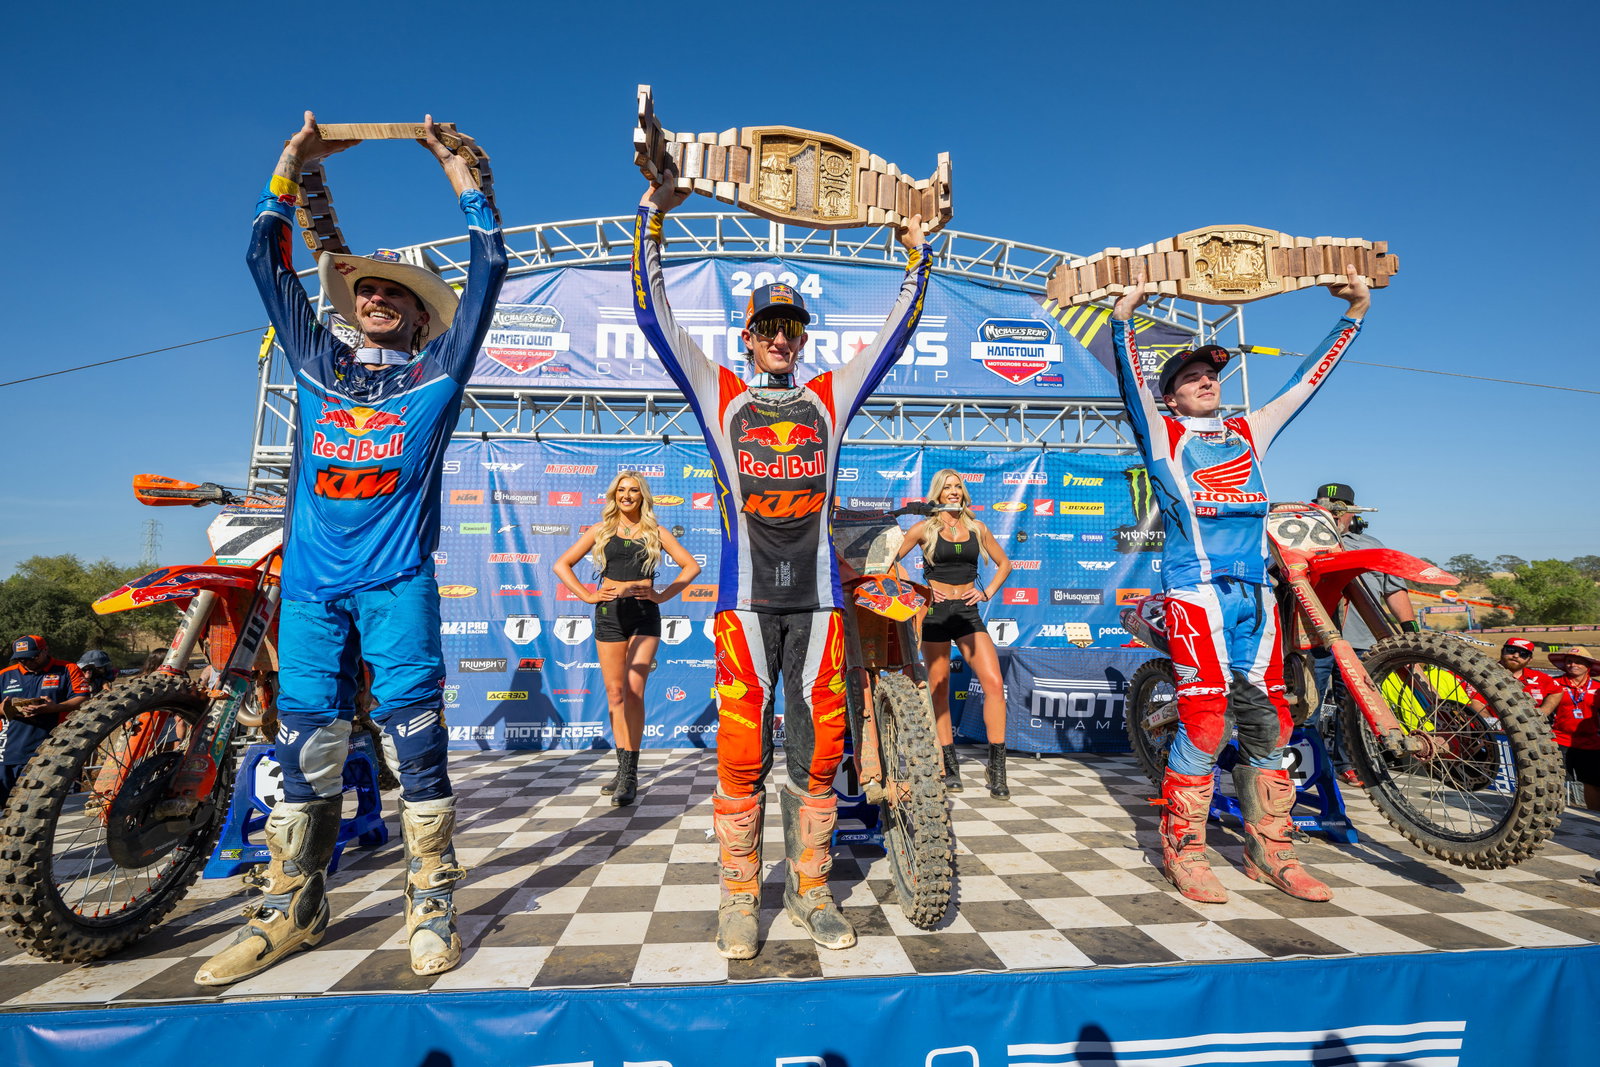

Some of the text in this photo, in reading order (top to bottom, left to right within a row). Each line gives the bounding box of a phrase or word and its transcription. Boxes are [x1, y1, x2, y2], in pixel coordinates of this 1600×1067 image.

[730, 271, 823, 299] 2024
[731, 310, 819, 325] PO
[1027, 328, 1048, 337] RENO
[490, 333, 553, 347] HANGTOWN
[987, 345, 1045, 358] HANGTOWN
[1308, 327, 1354, 386] HONDA
[1128, 329, 1145, 389] HONDA
[312, 431, 405, 463] Red Bull
[618, 464, 664, 472] PARTS
[738, 449, 826, 479] Red Bull
[314, 464, 402, 501] KTM
[1003, 472, 1047, 480] PARTS
[1072, 477, 1105, 487] THOR
[502, 493, 538, 503] Husqvarna
[741, 489, 827, 518] KTM
[1193, 491, 1268, 503] HONDA
[858, 500, 892, 509] Husqvarna
[1196, 507, 1217, 516] ヨシムラ
[214, 516, 285, 556] 7
[532, 525, 562, 534] TRIUMPH
[1277, 519, 1339, 548] 96
[688, 589, 714, 598] KTM
[1062, 593, 1101, 601] Husqvarna
[1292, 585, 1325, 627] SHOWA
[467, 621, 489, 630] PRO
[460, 660, 498, 671] TRIUMPH
[1340, 658, 1382, 717] DUNLOP
[447, 693, 454, 701] 2
[488, 692, 527, 700] ACERBIS
[219, 690, 246, 740] MOTOREX
[505, 726, 604, 738] MOTOCROSS
[1282, 748, 1307, 780] 2
[842, 756, 859, 796] 1
